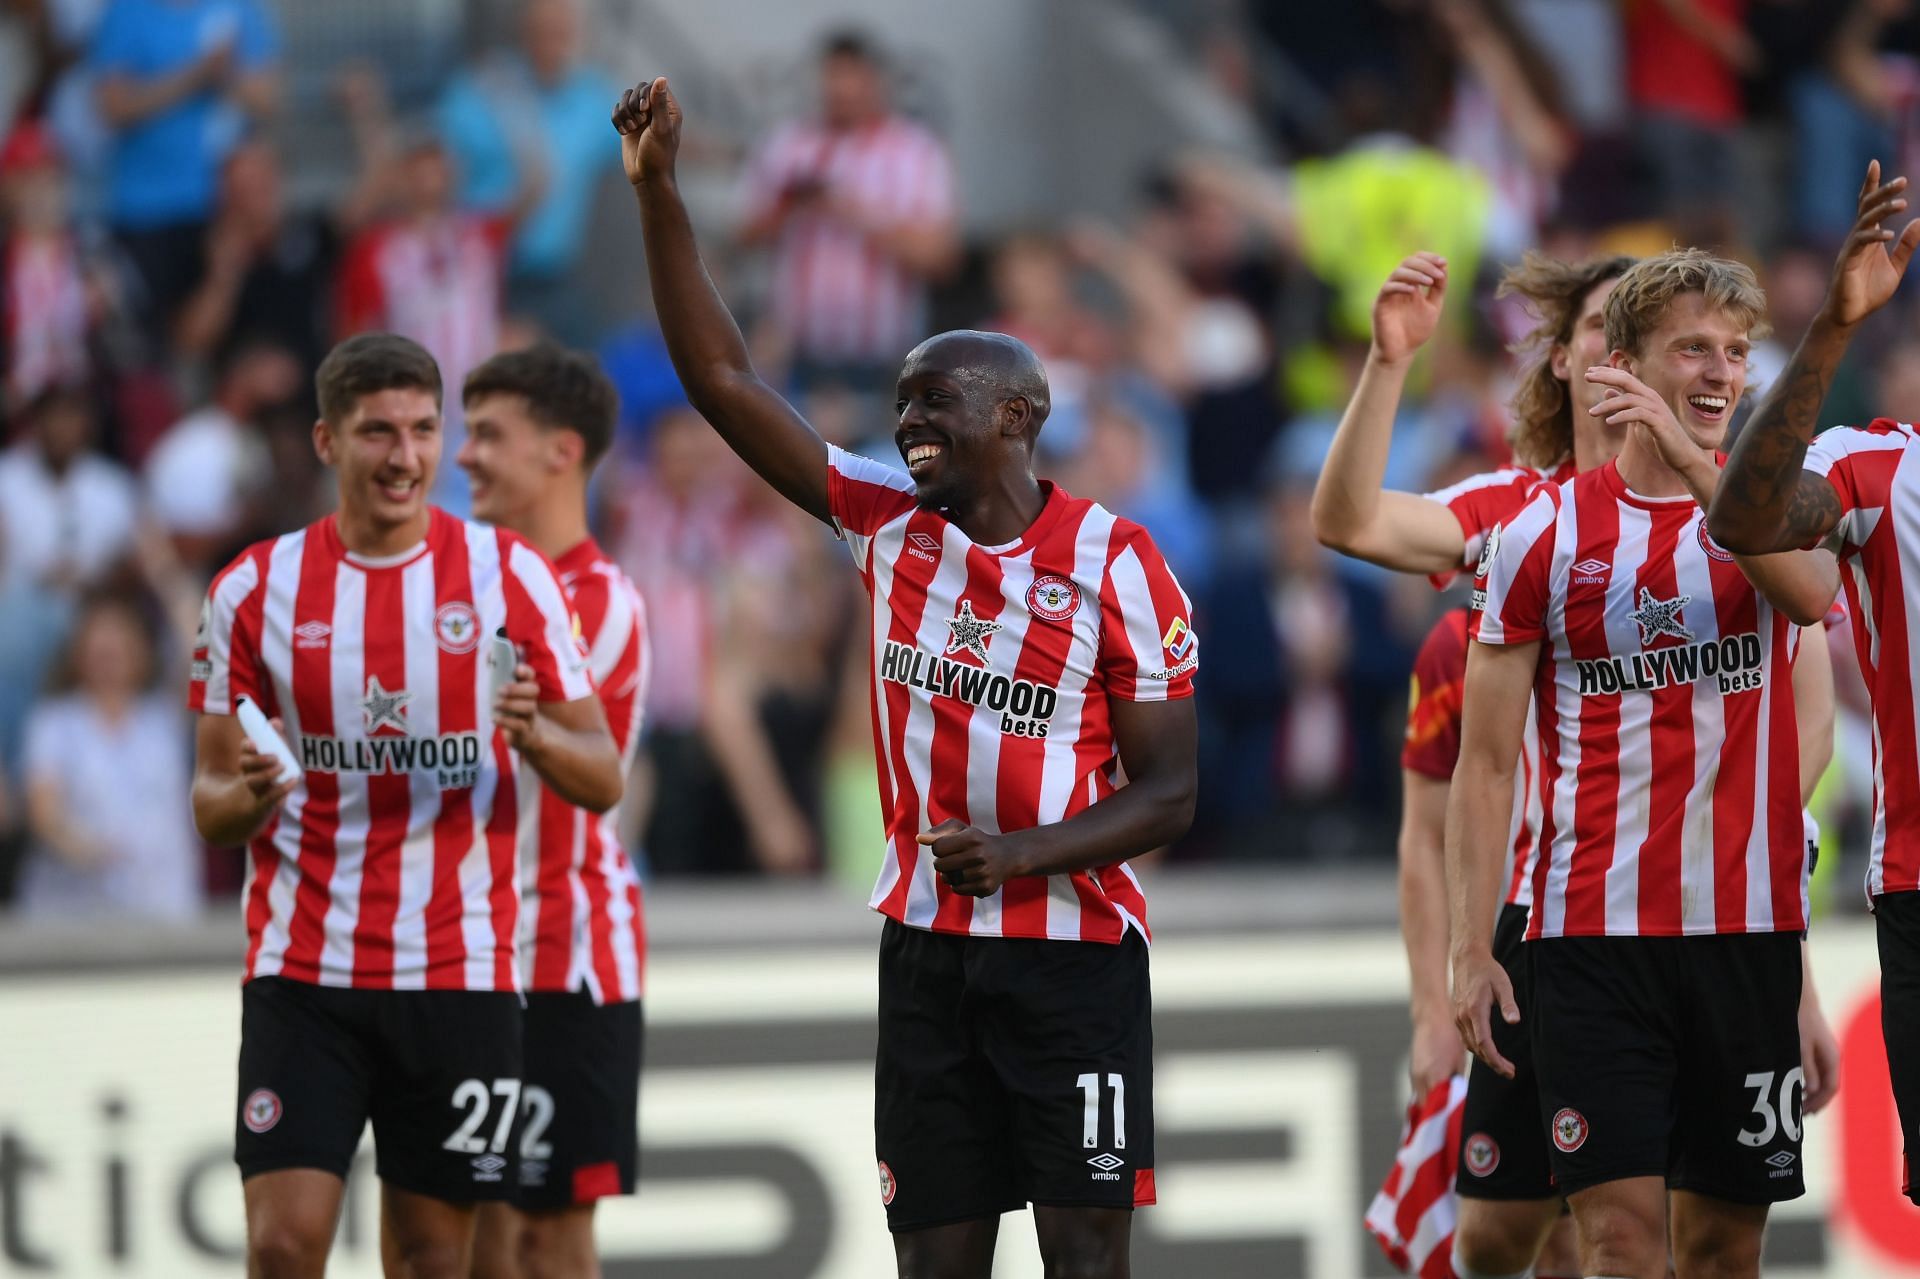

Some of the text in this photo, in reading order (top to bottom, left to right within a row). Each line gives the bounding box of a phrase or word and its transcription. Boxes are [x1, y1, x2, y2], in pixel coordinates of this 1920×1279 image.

[908, 547, 935, 563] umbro
[1574, 576, 1605, 584] umbro
[1576, 633, 1762, 694] HOLLYWOOD
[881, 642, 1058, 720] HOLLYWOOD
[1718, 670, 1762, 693] bets
[1001, 711, 1049, 738] bets
[302, 736, 478, 772] HOLLYWOOD
[438, 769, 477, 786] bets
[442, 1078, 522, 1154] 27
[1076, 1072, 1126, 1150] 11
[1737, 1066, 1802, 1147] 30
[1091, 1171, 1121, 1181] umbro
[1769, 1168, 1793, 1179] umbro
